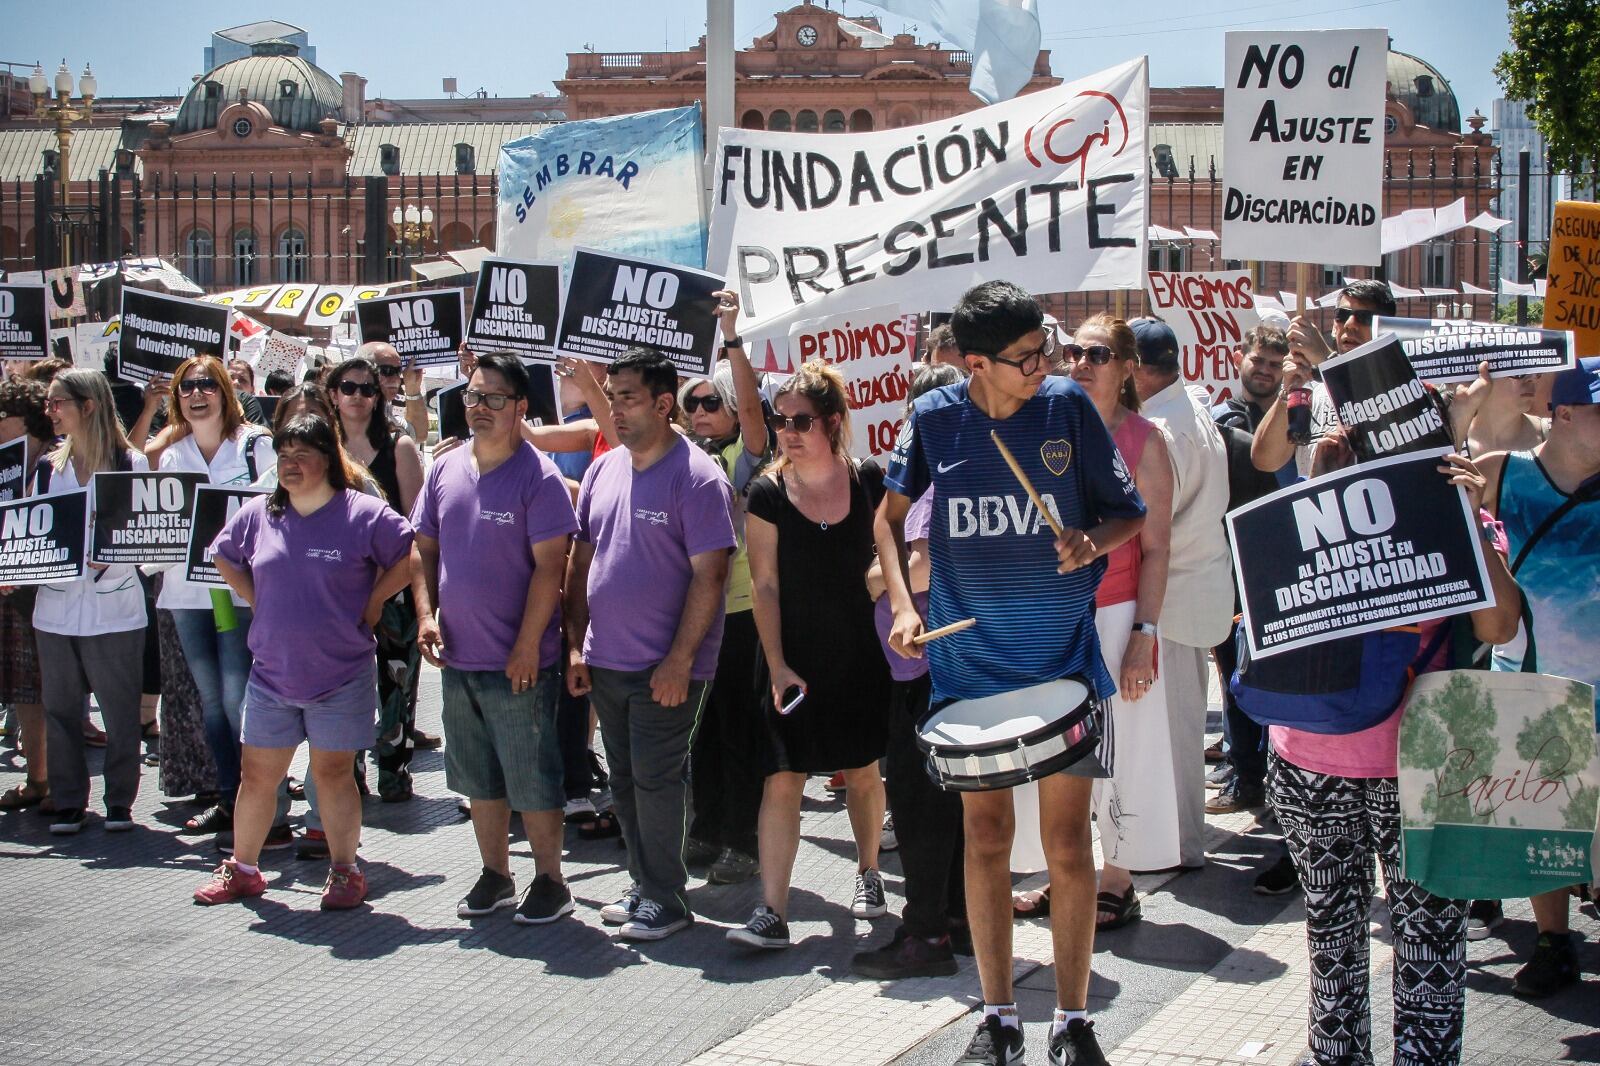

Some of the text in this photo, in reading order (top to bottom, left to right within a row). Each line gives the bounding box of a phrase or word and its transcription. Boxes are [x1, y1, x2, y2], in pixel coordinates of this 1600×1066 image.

[1237, 43, 1359, 90] NO al
[1249, 99, 1374, 144] AJUSTE
[1282, 155, 1324, 181] EN
[515, 151, 639, 224] SEMBRAR
[736, 172, 1137, 318] PRESENTE
[1563, 245, 1580, 262] DE
[489, 266, 527, 305] NO
[611, 264, 680, 310] NO
[125, 313, 221, 344] #HagamosVisible
[388, 298, 435, 329] NO
[474, 318, 546, 340] DISCAPACIDAD
[484, 304, 532, 323] AL AJUSTE EN
[602, 304, 678, 330] AL AJUSTE EN
[1187, 310, 1242, 346] UN
[389, 326, 440, 342] AL AJUSTE EN
[581, 315, 694, 350] DISCAPACIDAD
[1402, 331, 1541, 357] DISCAPACIDAD
[1448, 355, 1466, 365] PARA
[1466, 354, 1475, 363] LA
[1514, 350, 1519, 358] Y
[1528, 348, 1558, 357] DEFENSA
[131, 477, 185, 512] NO
[1, 503, 54, 540] NO
[127, 519, 136, 528] AL
[137, 513, 181, 528] AJUSTE
[948, 493, 1065, 538] BBVA
[1291, 477, 1396, 552] NO
[4, 536, 56, 553] AJUSTE EN
[112, 528, 189, 545] DISCAPACID
[0, 547, 69, 566] CAPACIDAD
[1299, 535, 1414, 580] AL AJUSTE EN
[1275, 552, 1447, 612] DISCAPACIDAD
[1262, 590, 1478, 646] DE LOS DERECHOS DE LAS PERSONAS CON DISCAPACIDAD
[1264, 579, 1471, 634] FORO PERMANENTE PARA LA PROMOCIÓN Y LA DEFENSA
